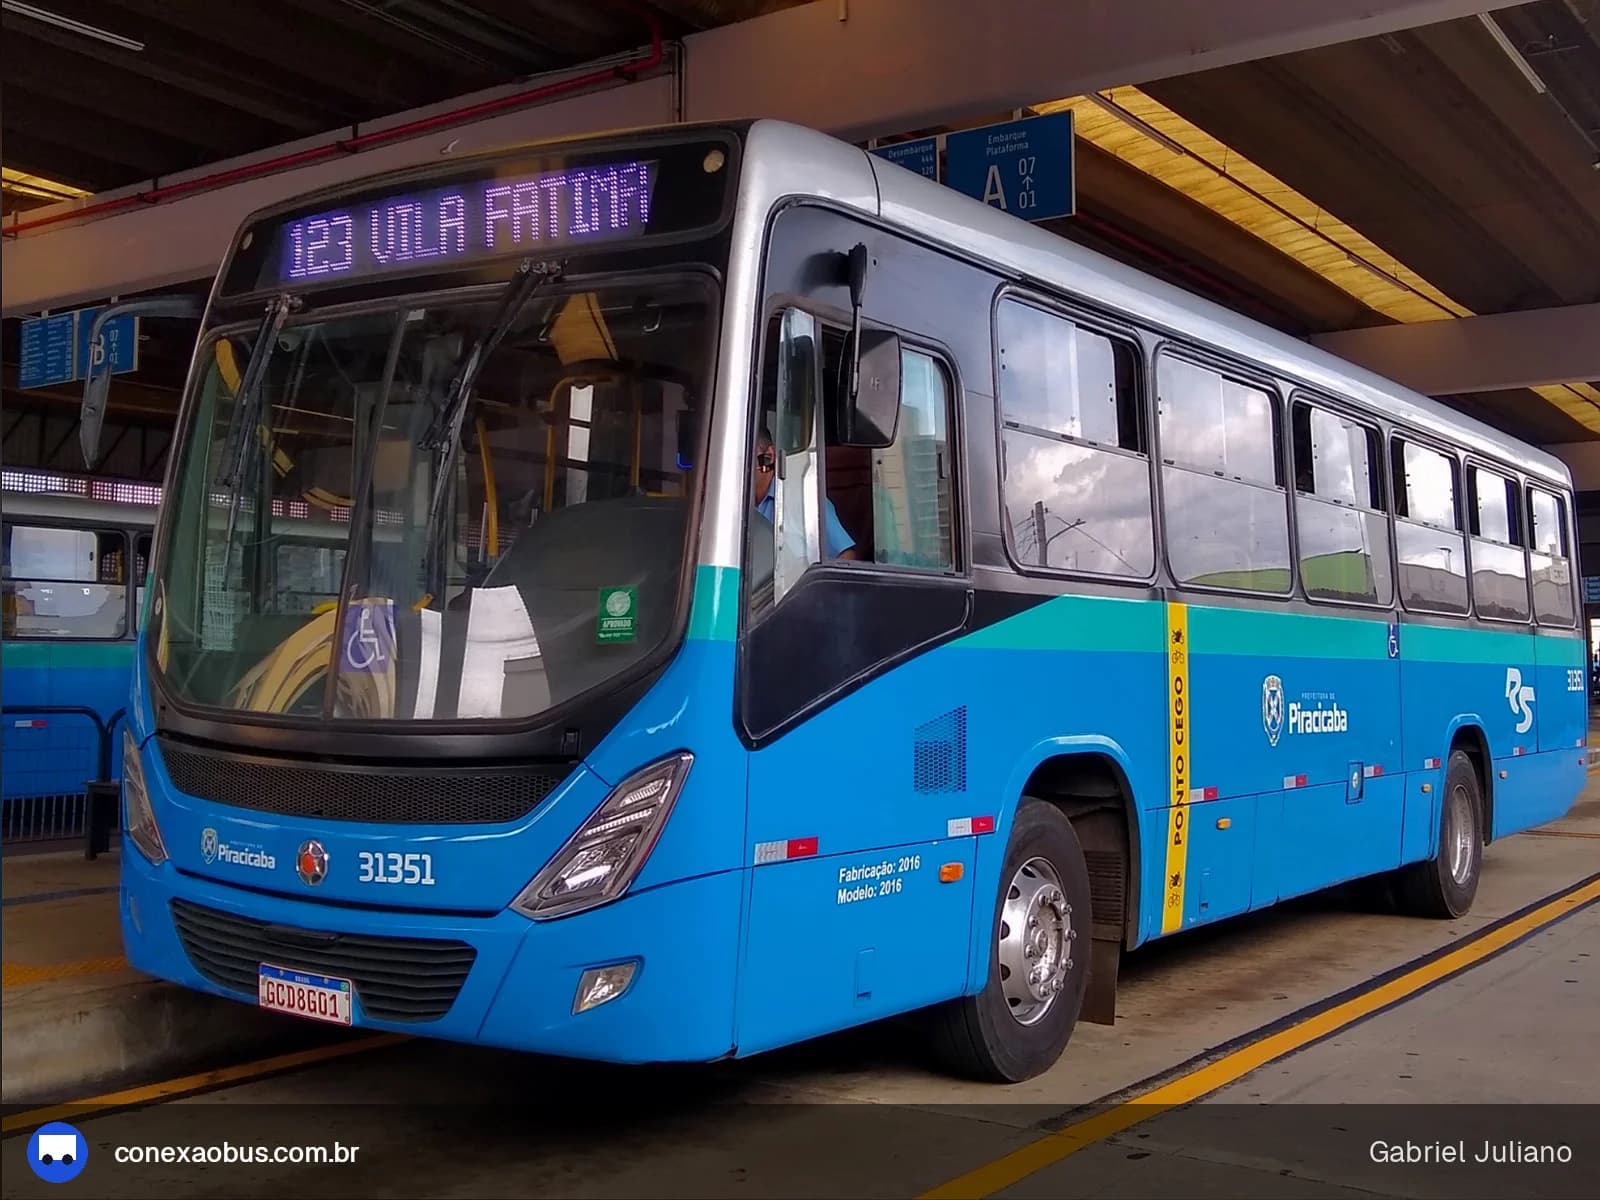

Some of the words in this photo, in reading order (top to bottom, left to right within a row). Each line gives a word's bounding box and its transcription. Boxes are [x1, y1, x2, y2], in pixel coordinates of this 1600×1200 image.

[986, 141, 1029, 157] Plataforma
[988, 130, 1027, 145] Embarque
[1018, 157, 1036, 176] 07
[983, 165, 1007, 210] A
[1018, 190, 1037, 209] 01
[289, 216, 353, 277] 123
[371, 194, 465, 263] VILA
[485, 162, 649, 247] FATIMA
[1175, 676, 1184, 746] CEGO
[1289, 701, 1347, 734] Piracicaba
[1174, 755, 1184, 846] PONTO
[218, 844, 276, 869] Piracicaba
[359, 852, 435, 885] 31351
[839, 861, 896, 883] Fabricação:
[898, 855, 920, 872] 2016
[837, 885, 877, 904] Modelo:
[880, 879, 902, 895] 2016
[266, 981, 339, 1018] GCD8G01
